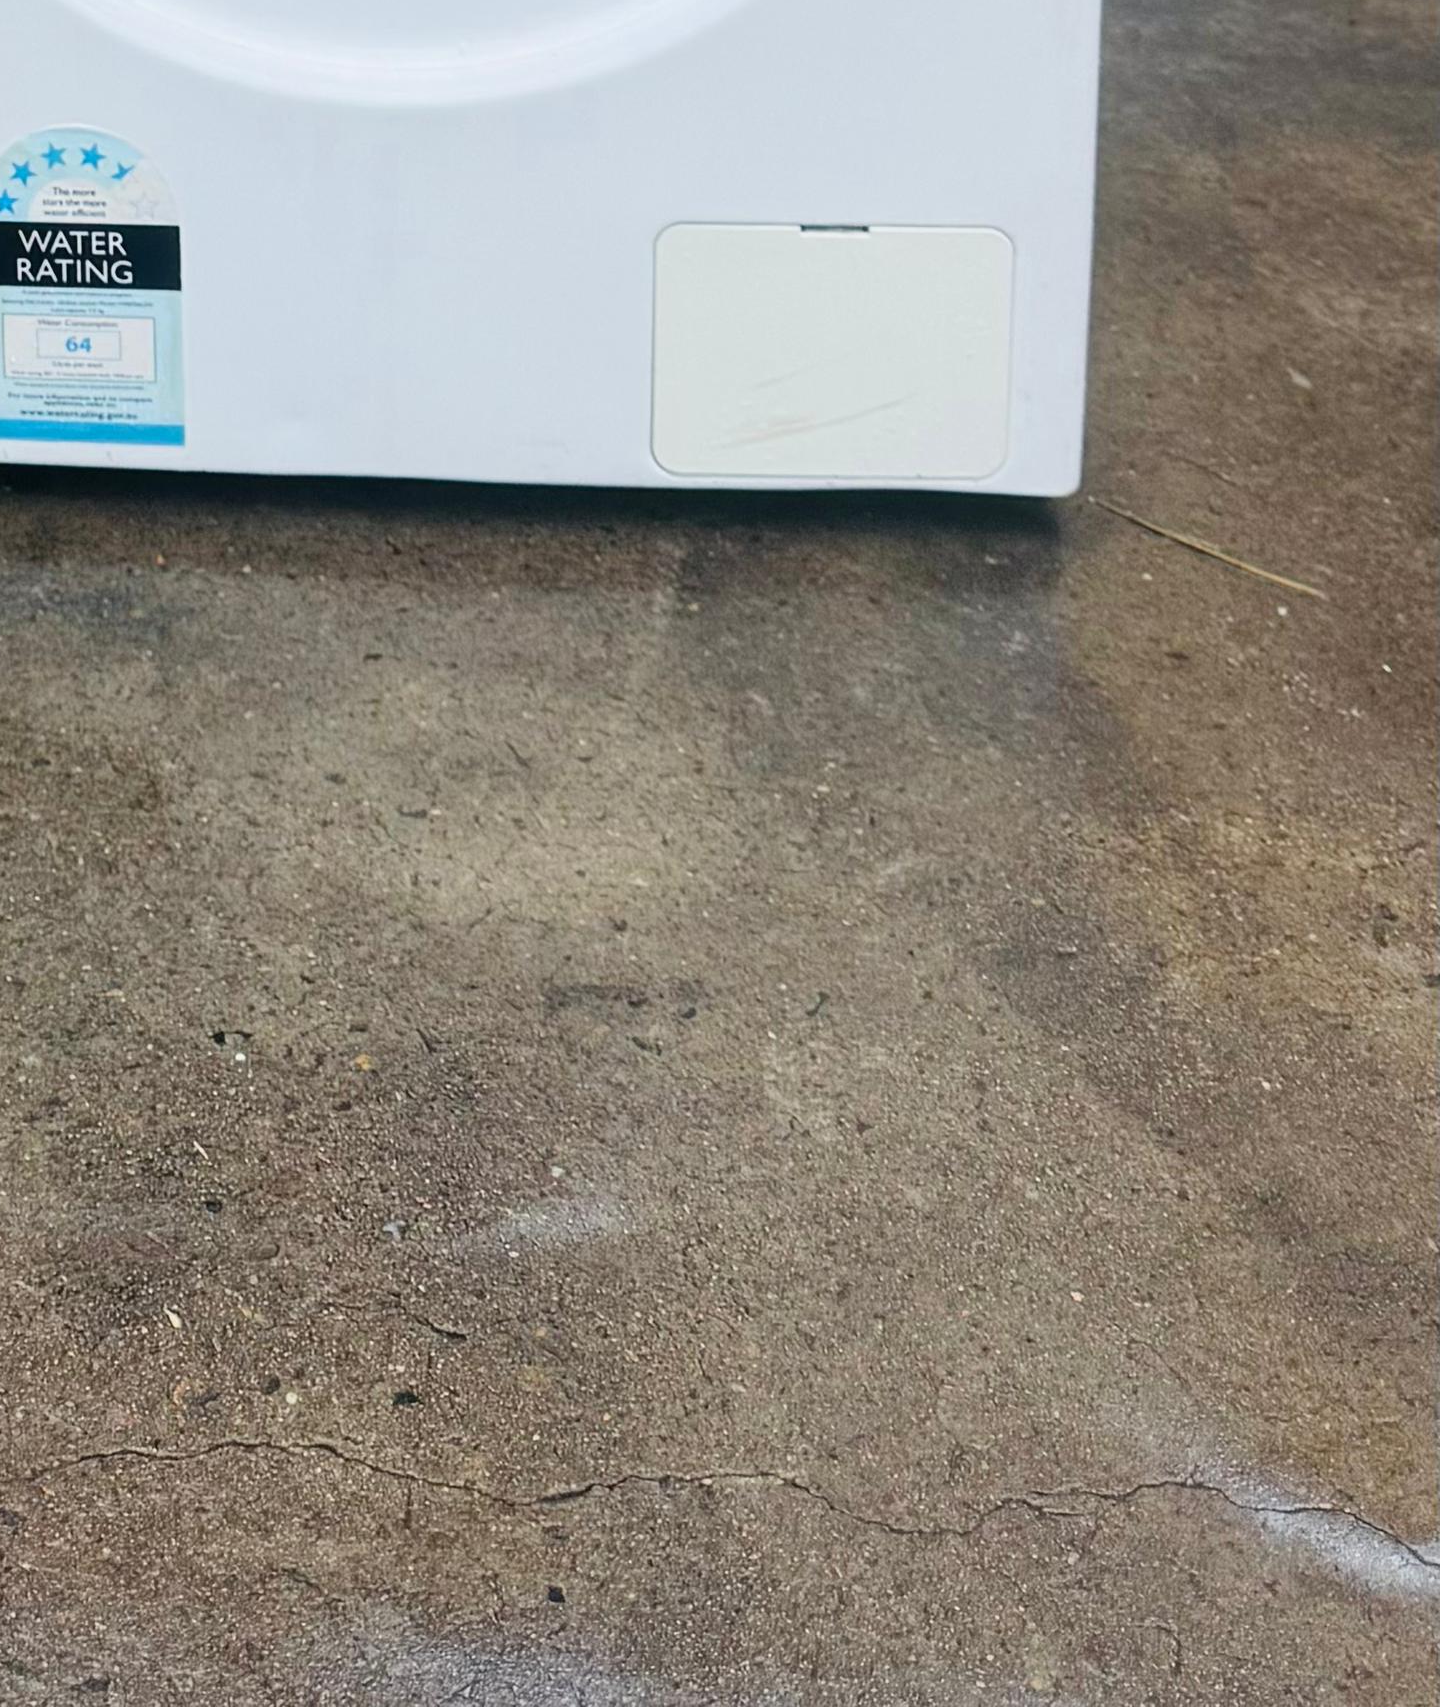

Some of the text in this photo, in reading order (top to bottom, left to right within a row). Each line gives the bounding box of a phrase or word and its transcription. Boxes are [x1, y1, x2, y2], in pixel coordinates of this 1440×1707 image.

[53, 187, 69, 196] The
[65, 199, 80, 207] the
[18, 229, 127, 256] WATER
[17, 258, 133, 284] RATING
[65, 336, 92, 353] 64
